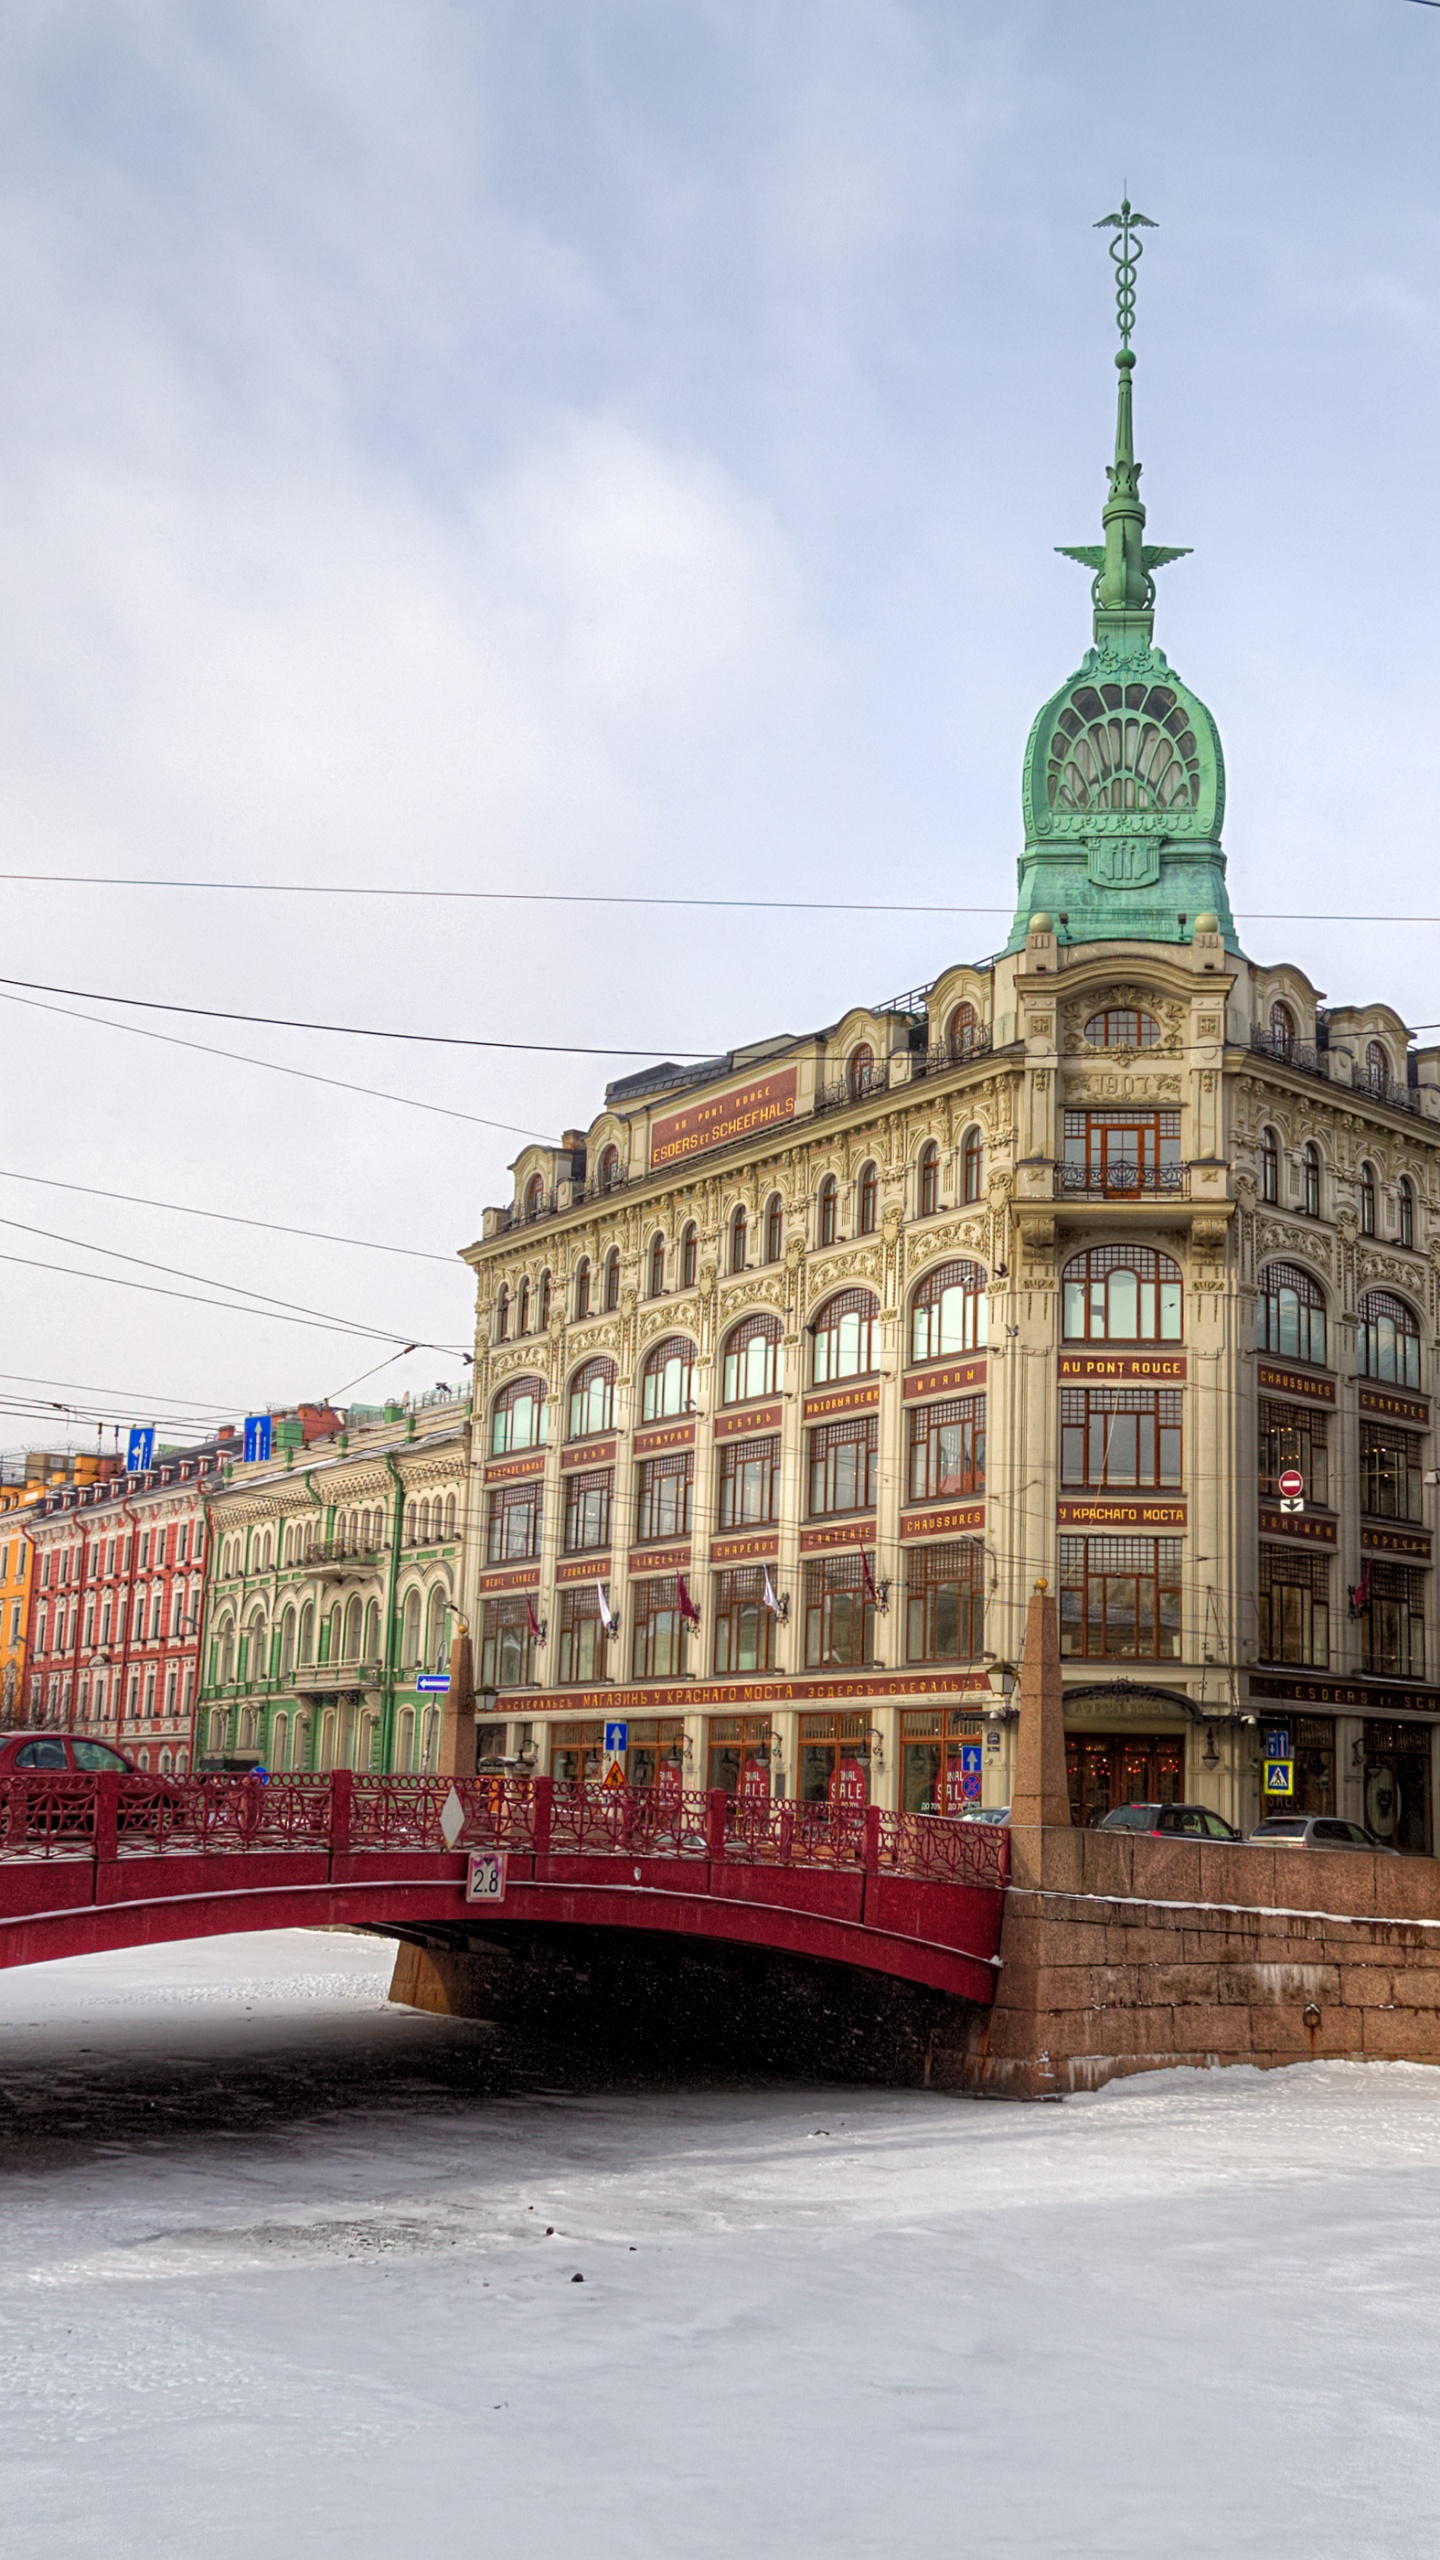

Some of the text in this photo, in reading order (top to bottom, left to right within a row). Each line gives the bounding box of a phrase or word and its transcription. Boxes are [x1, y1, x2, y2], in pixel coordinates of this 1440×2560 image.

[1095, 1075, 1150, 1095] 1907
[675, 1086, 770, 1131] AU PONT ROUGE
[653, 1097, 795, 1163] ESDERS ET SCHEEFHALS
[1063, 1362, 1181, 1373] AU PONT ROUGE
[1260, 1370, 1331, 1396] CHAUSSURES
[1361, 1394, 1424, 1418] CRAVATES
[727, 1413, 771, 1430] ОБУВЬ
[906, 1512, 981, 1532] CHAUSSURES
[1059, 1508, 1184, 1520] У КРАСНАГО МОСТА
[1261, 1515, 1332, 1537] ЗОНТИКИ
[717, 1541, 774, 1557] CHAPEAUX
[1362, 1533, 1427, 1553] СОРОЧКИ
[583, 1689, 648, 1707] МАГАЗИНЪ
[654, 1692, 660, 1704] У
[667, 1687, 737, 1704] КРАСНАГО
[744, 1684, 793, 1701] МОСТА
[808, 1684, 874, 1698] ЭСДЕРСЪ
[1295, 1686, 1368, 1704] ESDERS
[937, 1784, 970, 1801] SAL
[473, 1869, 499, 1893] 2.8
